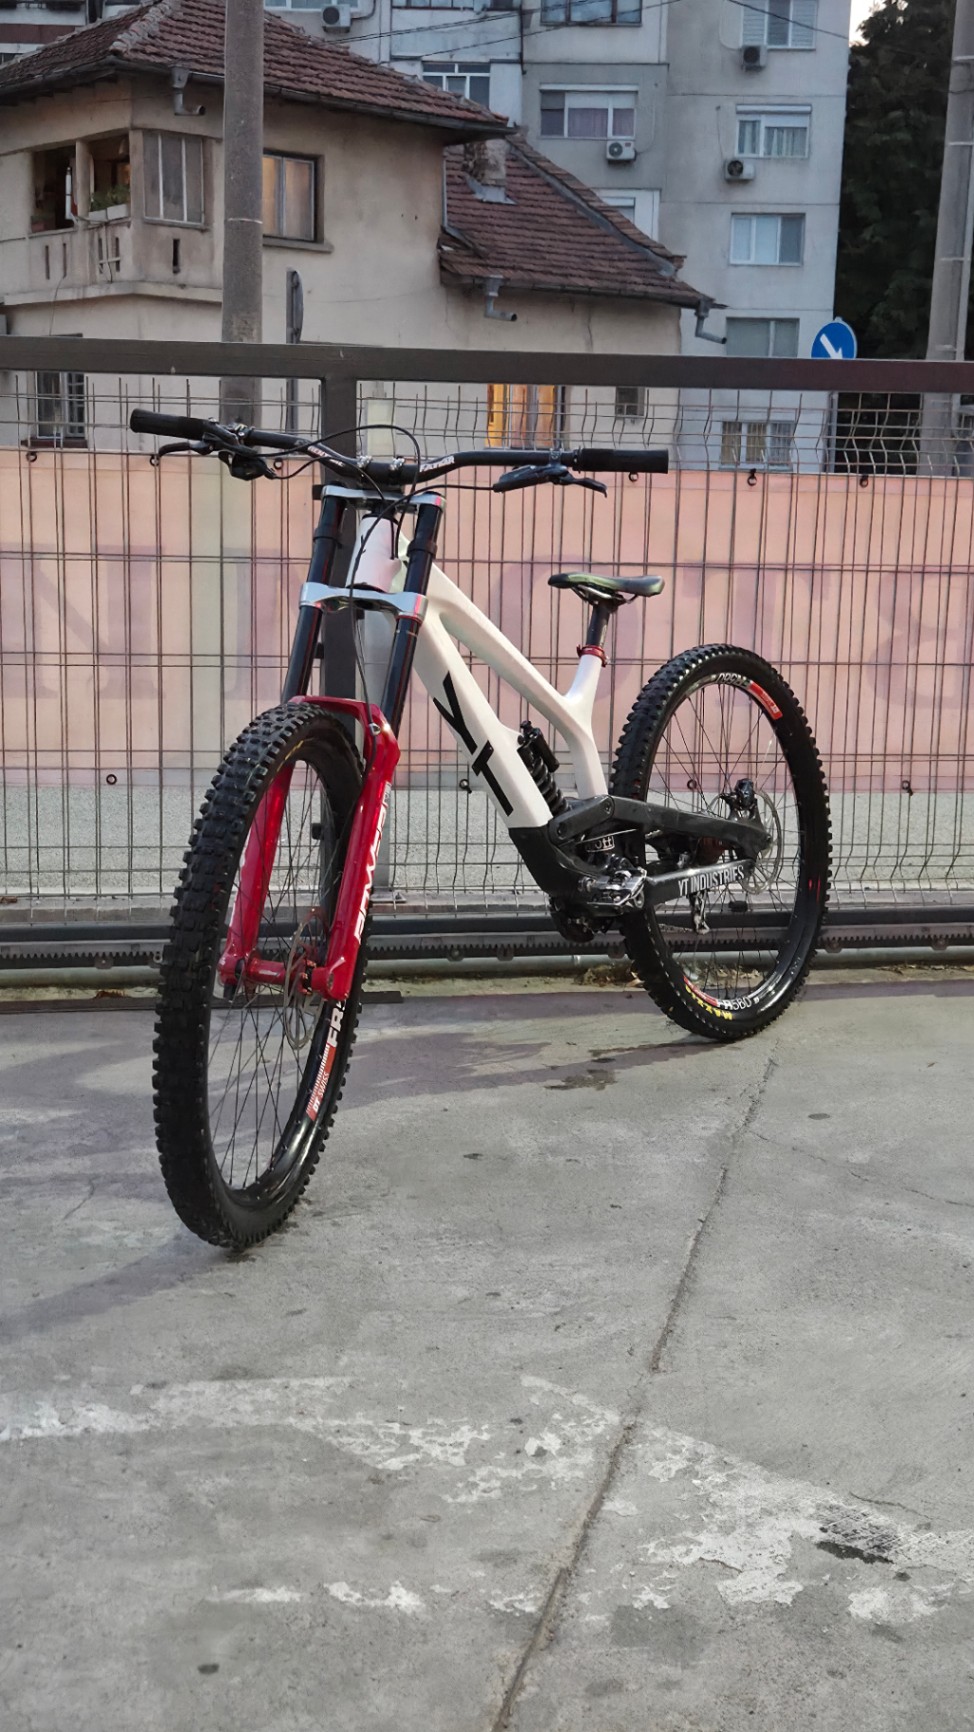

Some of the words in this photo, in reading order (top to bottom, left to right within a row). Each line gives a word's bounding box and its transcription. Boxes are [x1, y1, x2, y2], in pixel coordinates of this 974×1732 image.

[433, 671, 514, 817] YT
[678, 878, 689, 897] YT
[690, 865, 745, 893] INDUSTRIES
[312, 1099, 321, 1113] DT
[317, 1071, 330, 1098] SWISS
